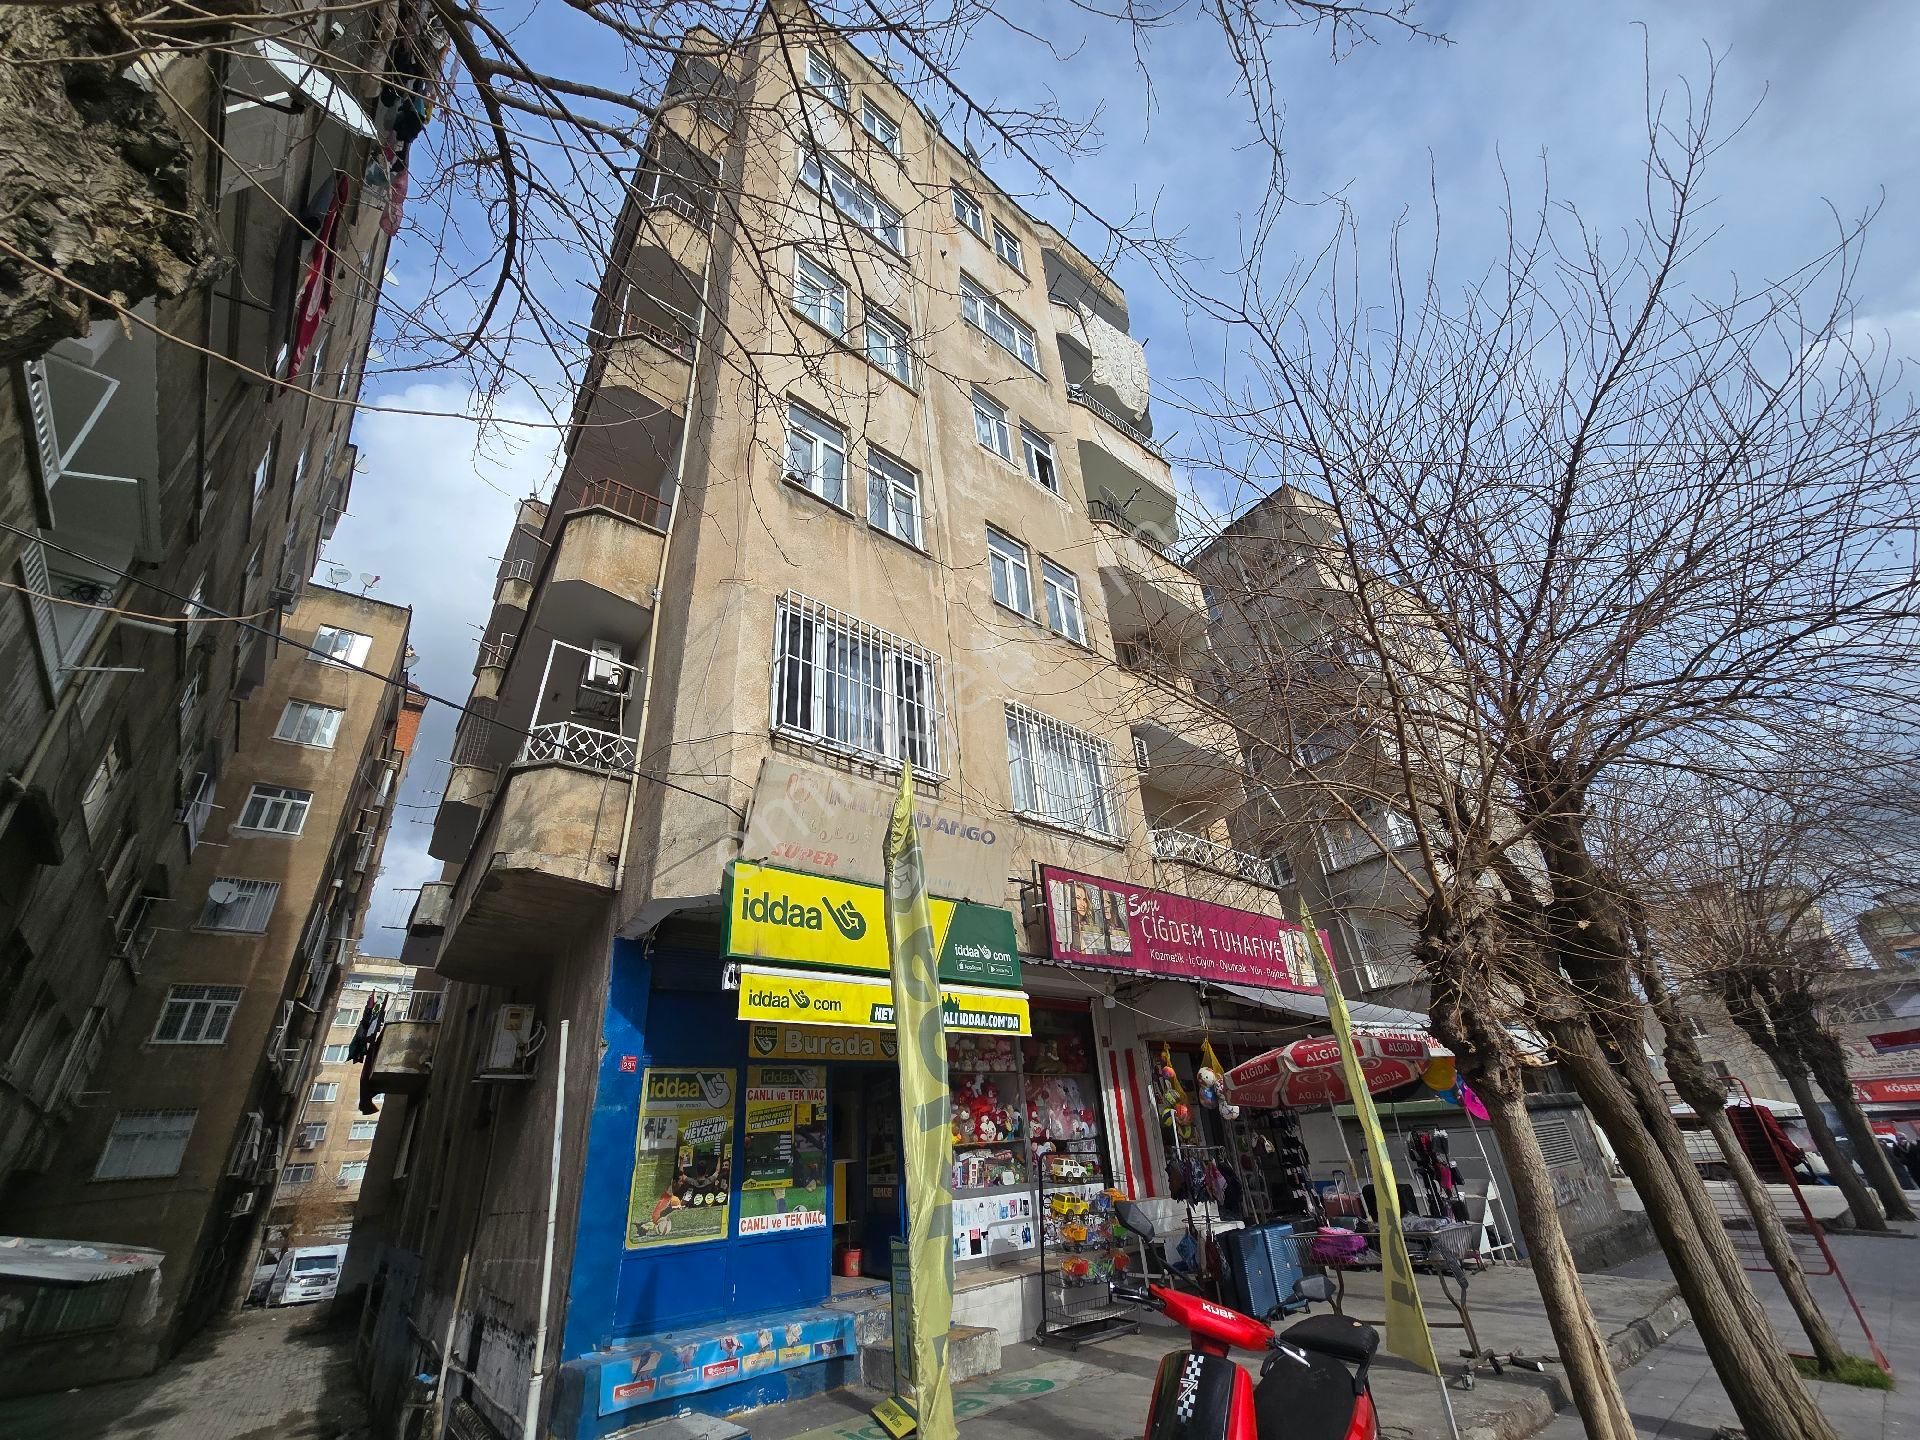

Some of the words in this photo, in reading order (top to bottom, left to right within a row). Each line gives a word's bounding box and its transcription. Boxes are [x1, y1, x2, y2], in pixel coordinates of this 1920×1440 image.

[741, 888, 823, 931] iddaa
[954, 943, 980, 959] iddaa
[993, 951, 1012, 962] com
[1150, 949, 1185, 964] Kozmetik
[748, 989, 790, 1009] iddaa
[813, 998, 842, 1012] com
[784, 1030, 874, 1056] Burada
[1306, 1047, 1341, 1063] ALGiD
[763, 1070, 797, 1084] iddaa
[650, 1077, 700, 1099] iddaa
[747, 1089, 774, 1101] CANLI
[776, 1091, 786, 1100] ve
[788, 1090, 804, 1100] TEK
[740, 1215, 769, 1233] CANLI
[772, 1219, 782, 1227] ve
[785, 1213, 802, 1227] TEK
